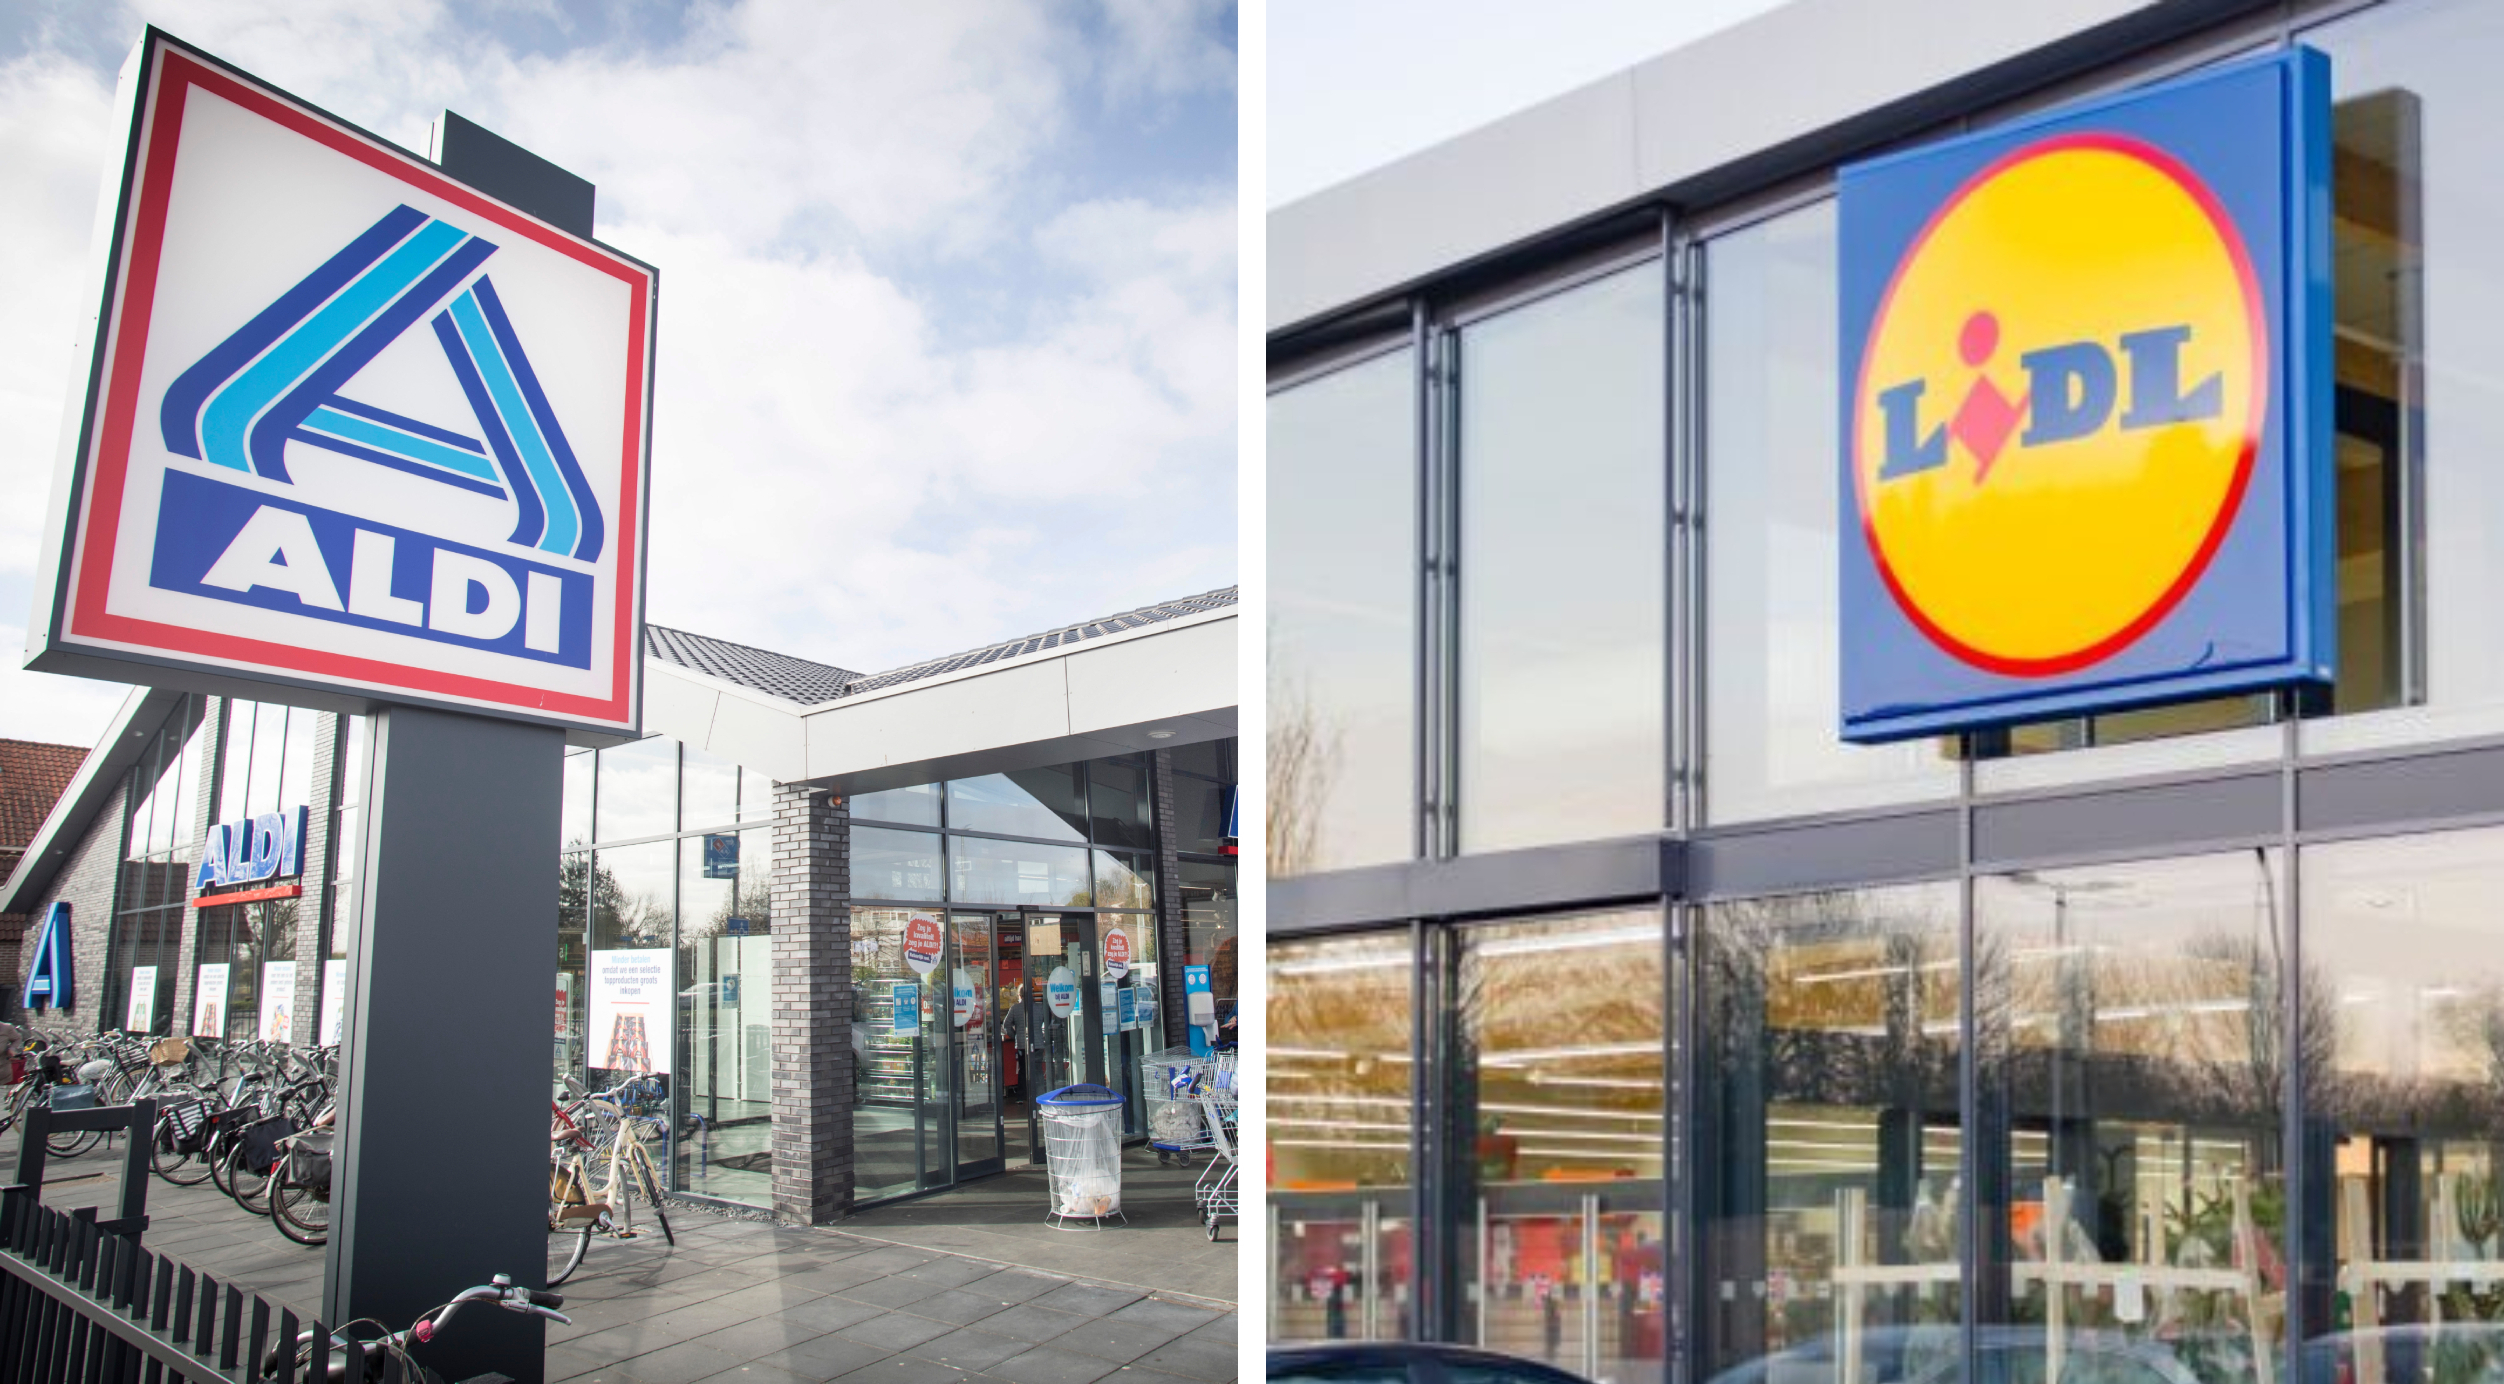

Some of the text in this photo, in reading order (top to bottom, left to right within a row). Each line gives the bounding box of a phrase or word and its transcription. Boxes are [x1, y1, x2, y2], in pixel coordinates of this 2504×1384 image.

[200, 504, 563, 655] ALDI
[194, 805, 309, 890] ALDI
[611, 954, 651, 964] Minder betalen
[602, 965, 619, 974] omdat
[628, 966, 639, 974] een
[639, 965, 661, 974] selectie
[604, 975, 658, 986] topproducten groots
[619, 986, 641, 996] inkopen
[1049, 982, 1074, 993] Welkom
